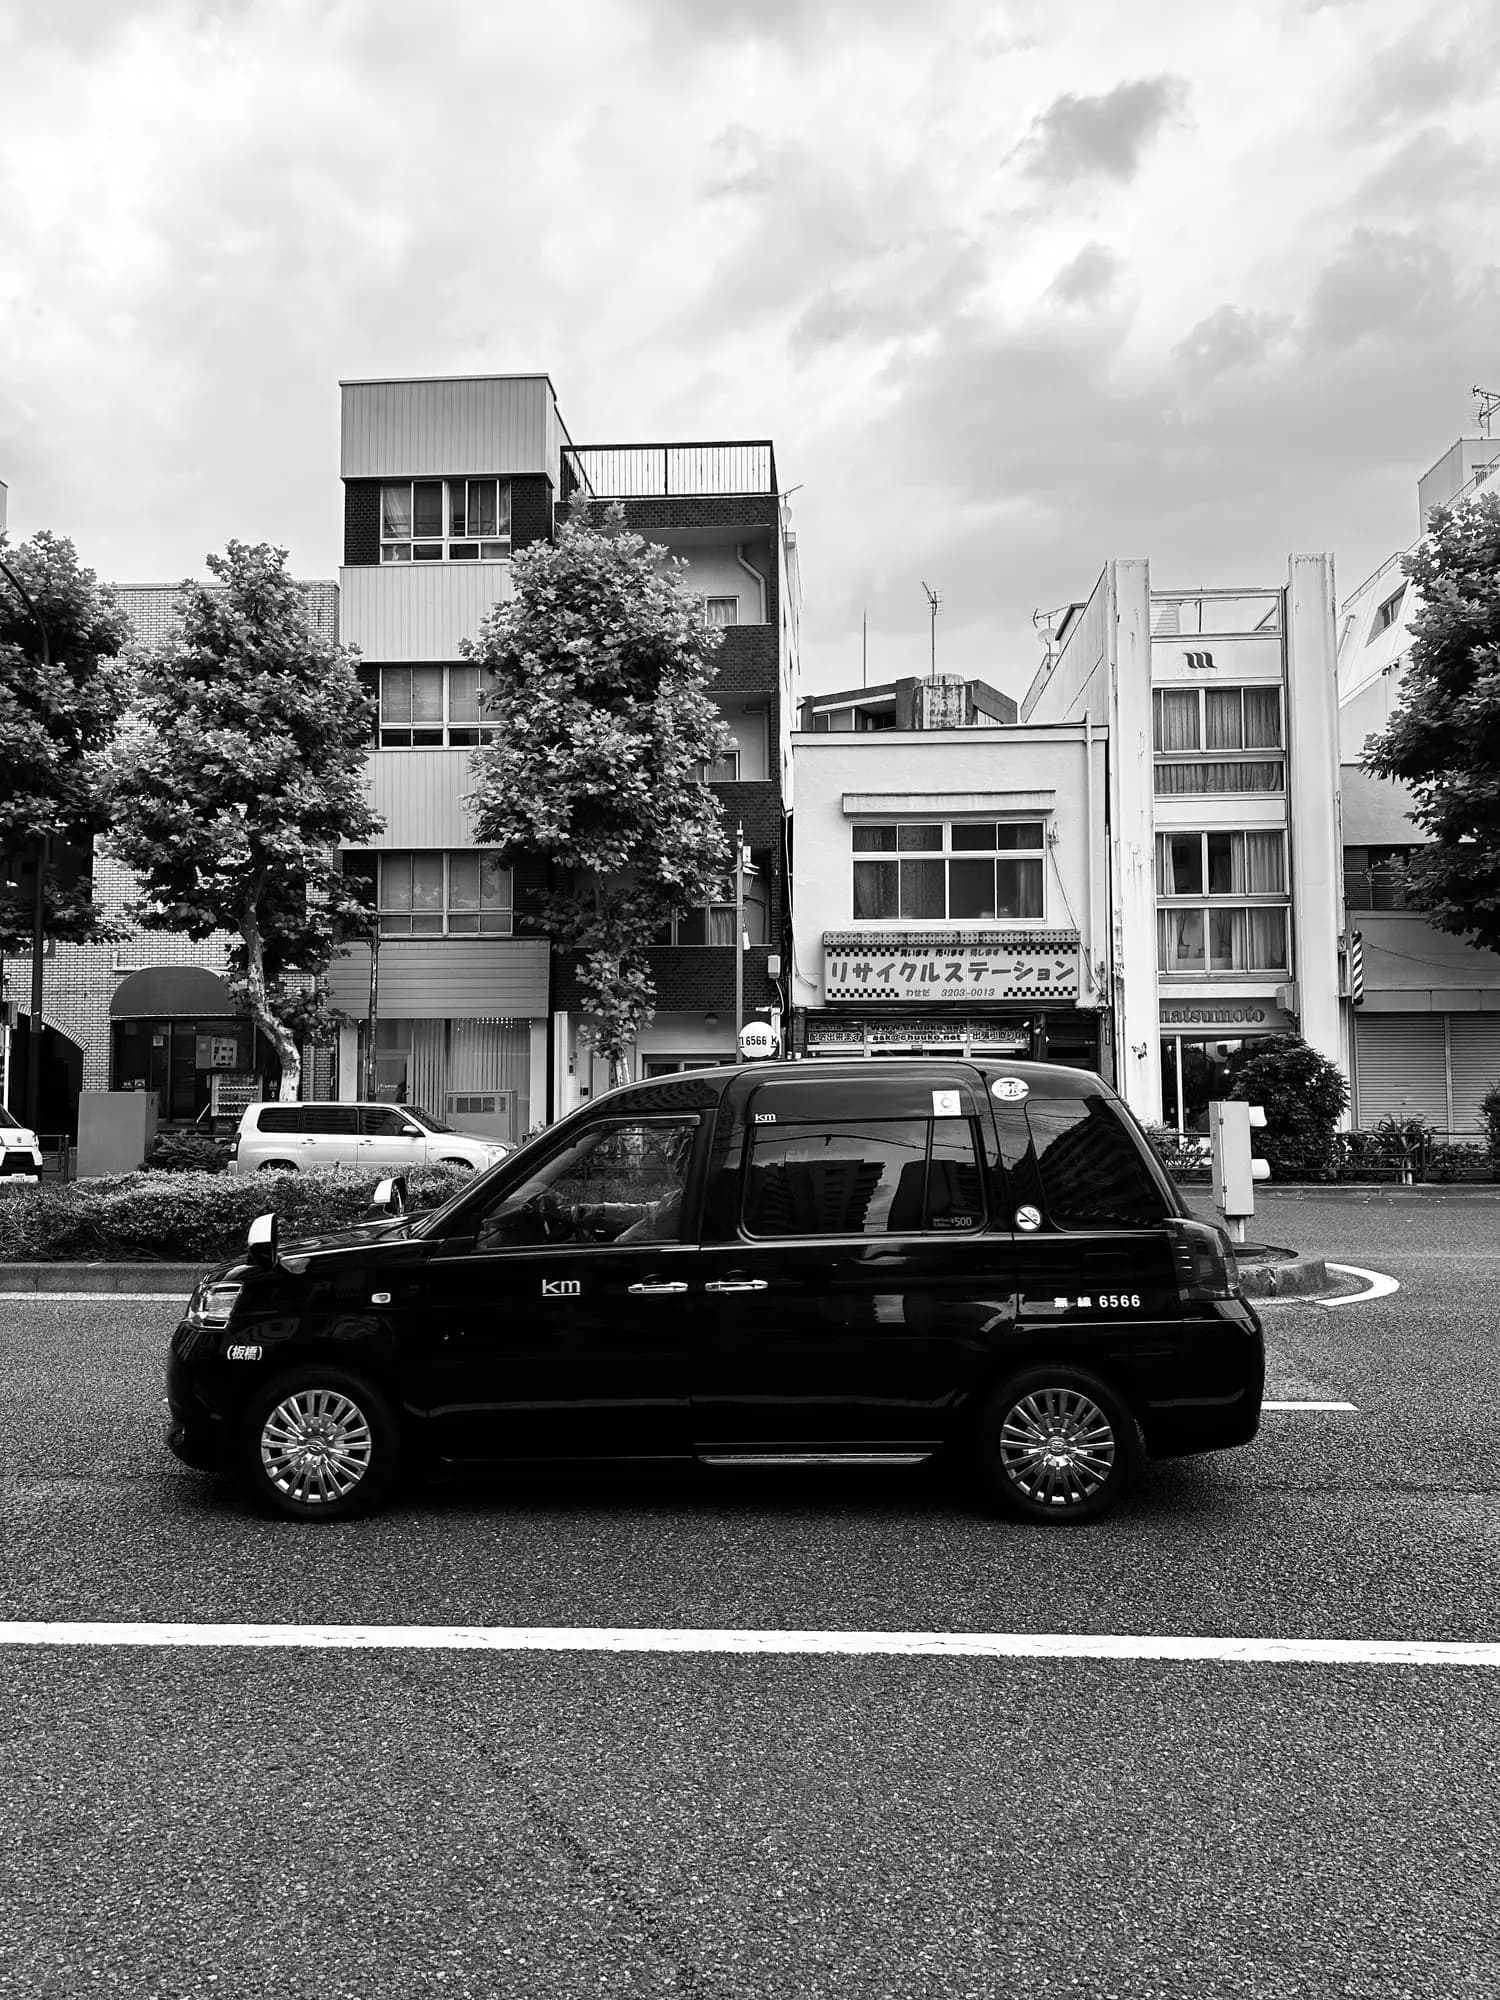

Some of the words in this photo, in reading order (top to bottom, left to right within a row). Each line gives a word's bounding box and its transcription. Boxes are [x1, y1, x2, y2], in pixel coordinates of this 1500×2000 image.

[831, 960, 1075, 983] リサイクルステーション
[940, 987, 995, 998] 3203-0013
[872, 1033, 961, 1041] ask@chuuko.net
[755, 1113, 776, 1122] km
[541, 1279, 581, 1294] km
[1099, 1294, 1140, 1308] 6566
